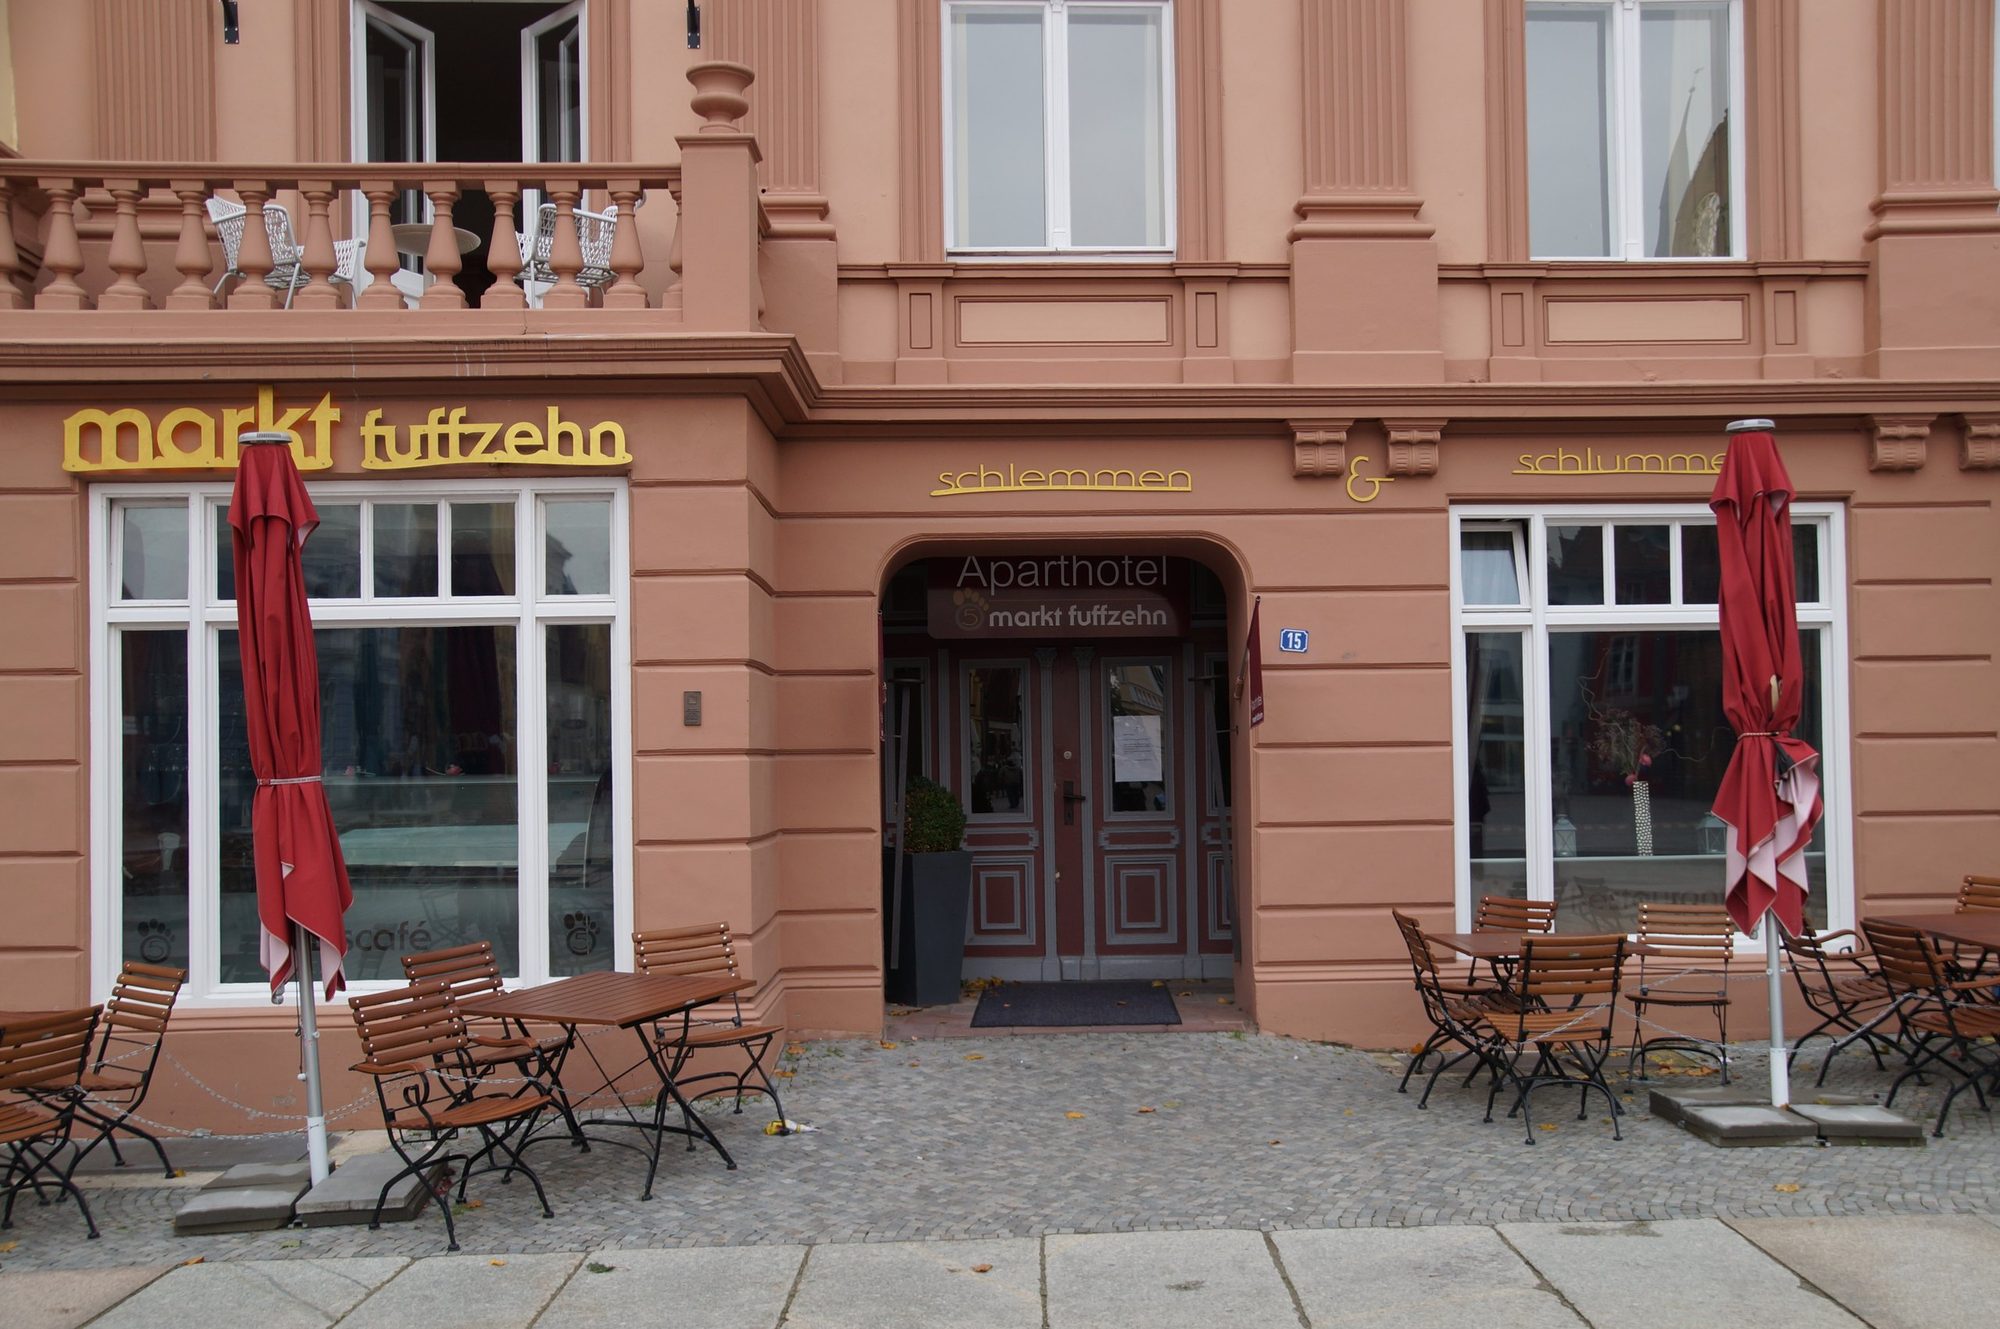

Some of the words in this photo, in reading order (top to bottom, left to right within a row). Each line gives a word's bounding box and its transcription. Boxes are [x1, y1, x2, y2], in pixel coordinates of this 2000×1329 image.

[62, 384, 340, 472] markt
[360, 405, 633, 470] fuffzehn
[929, 463, 1192, 496] schlemmen
[1346, 456, 1395, 501] &
[1512, 447, 1727, 475] schlumme
[956, 554, 1168, 597] Aparthotel
[988, 604, 1062, 628] markt
[1067, 603, 1169, 627] fuffzehn
[1287, 632, 1302, 650] 15
